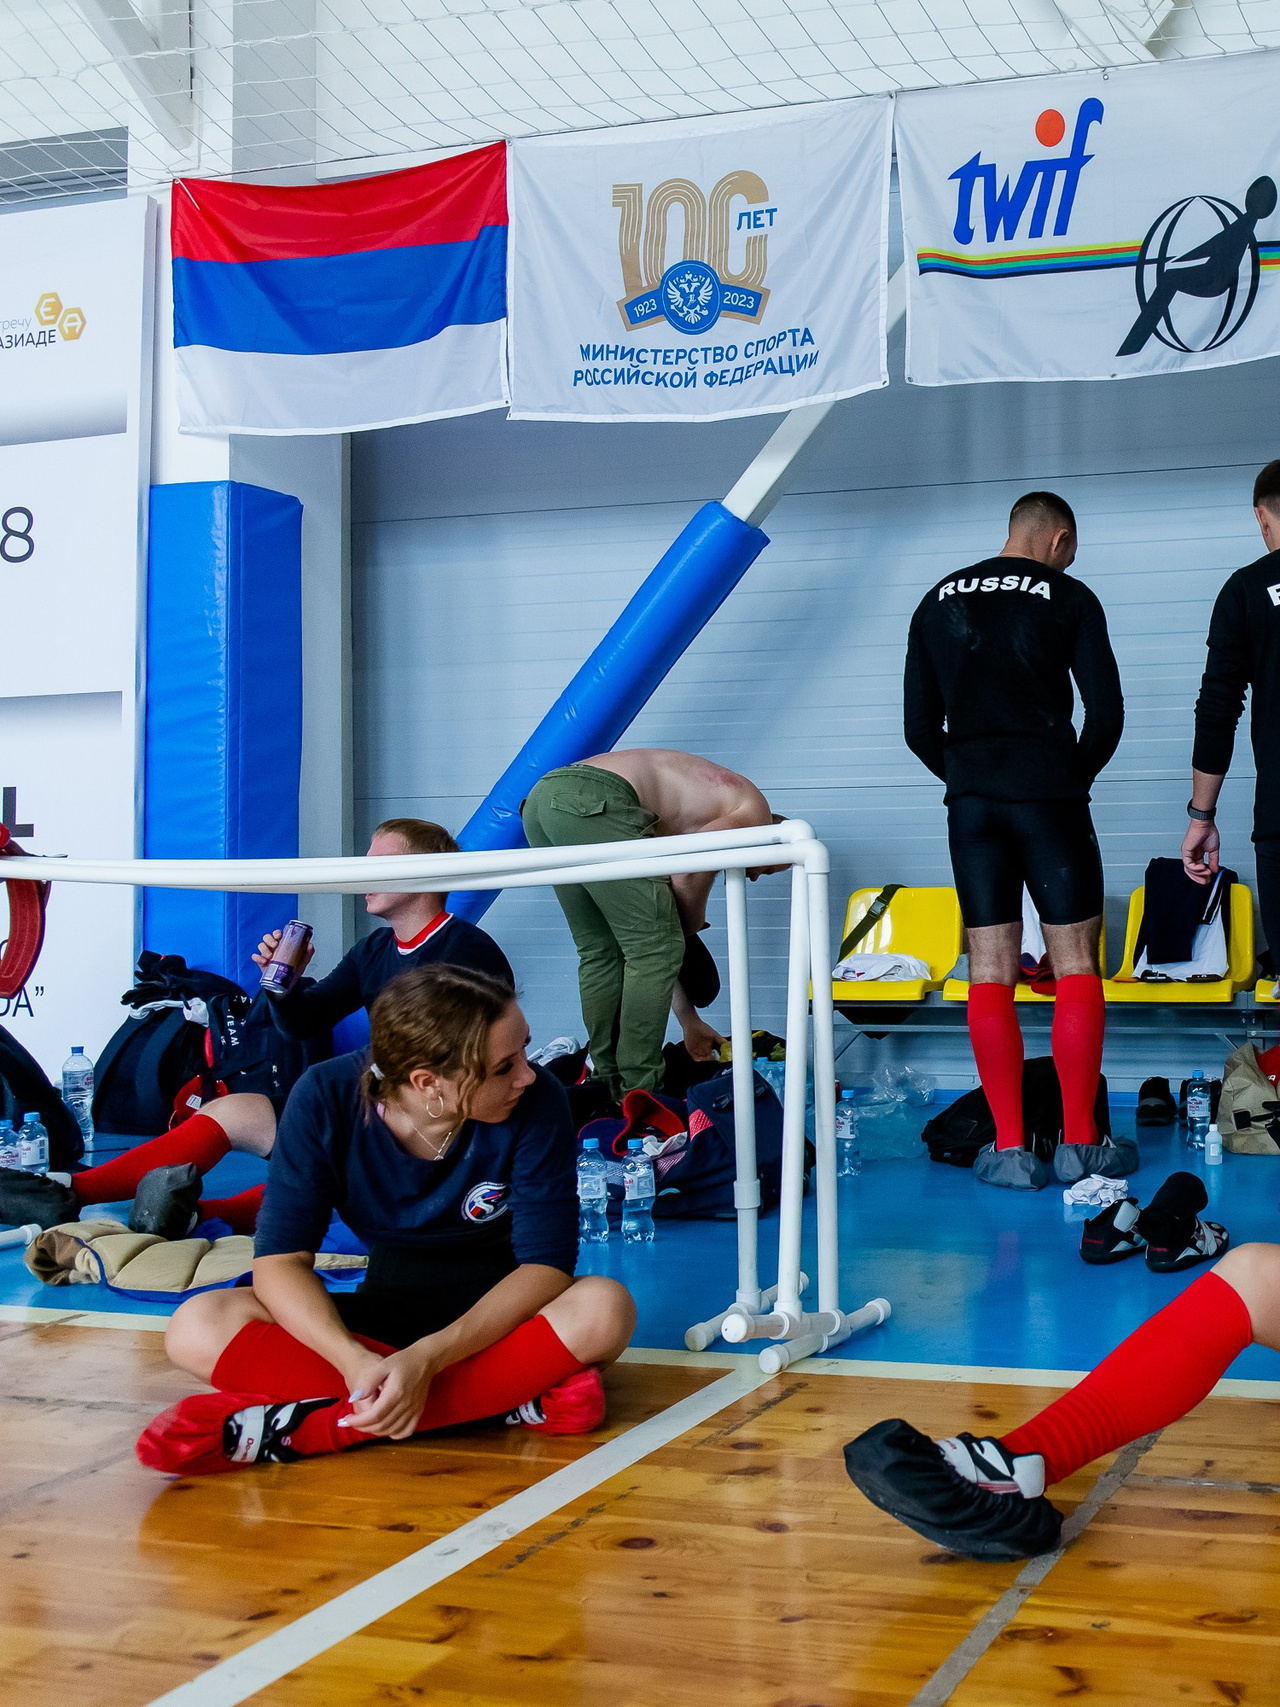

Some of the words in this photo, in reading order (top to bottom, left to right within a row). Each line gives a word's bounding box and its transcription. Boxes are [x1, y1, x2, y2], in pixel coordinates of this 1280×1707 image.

[947, 97, 1104, 245] twif
[612, 170, 769, 298] 100
[736, 208, 778, 231] ЛЕТ
[633, 298, 658, 318] 1923
[723, 291, 755, 309] 2023
[579, 344, 739, 366] МИНИСТЕРСТВО
[744, 327, 815, 359] СПОРТА
[572, 364, 698, 389] РОССИЙСКОЙ
[702, 350, 820, 388] ФЕДЕРАЦИИ
[0, 506, 35, 564] 8
[938, 574, 1051, 601] RUSSIA
